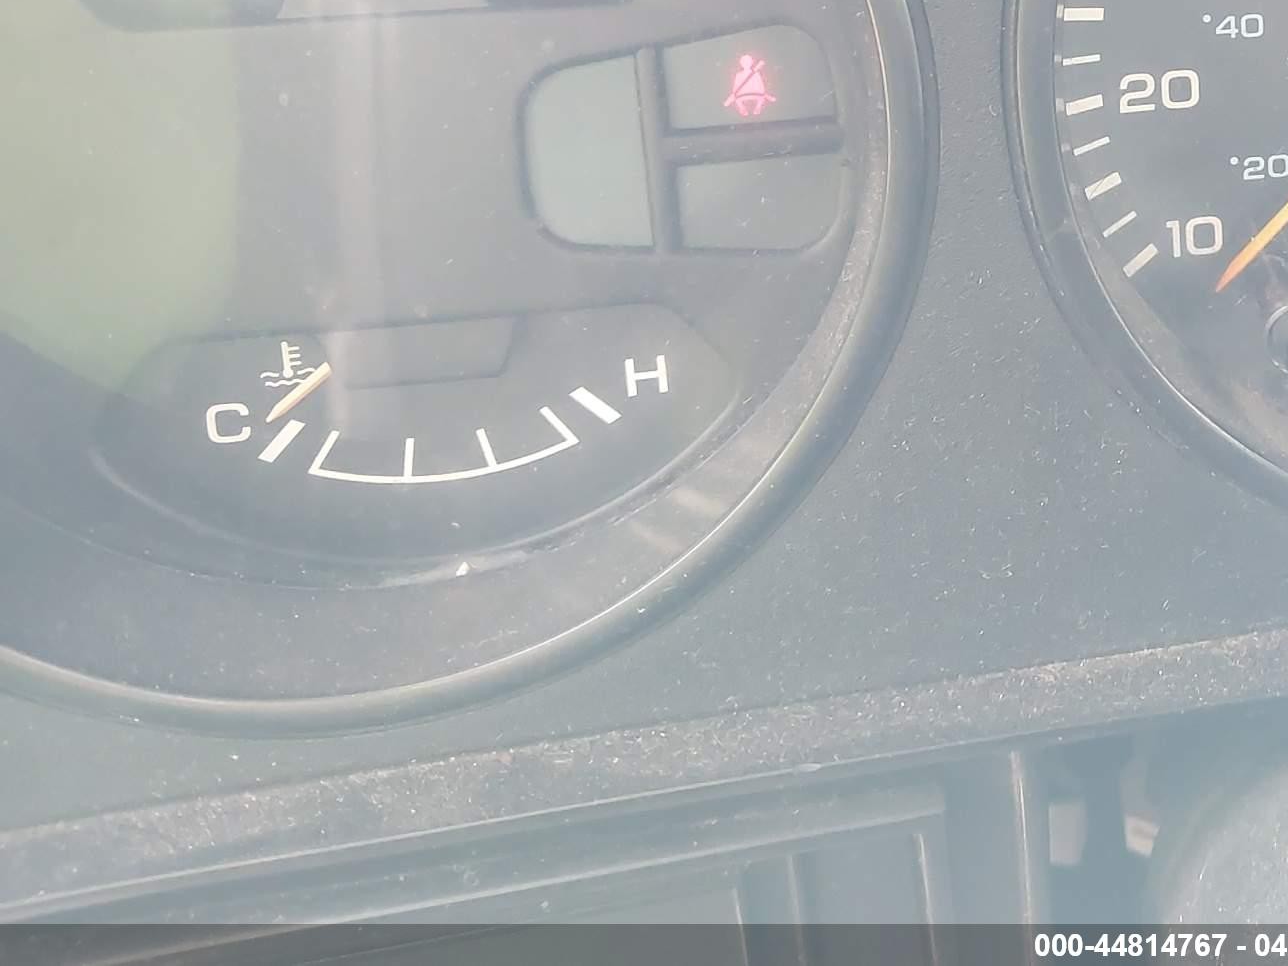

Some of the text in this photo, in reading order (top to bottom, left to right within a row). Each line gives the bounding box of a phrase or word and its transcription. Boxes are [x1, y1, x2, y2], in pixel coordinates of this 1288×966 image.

[1215, 13, 1264, 38] 40
[1119, 69, 1200, 113] 20
[1166, 215, 1223, 257] 10
[624, 355, 669, 397] H
[206, 402, 251, 444] C
